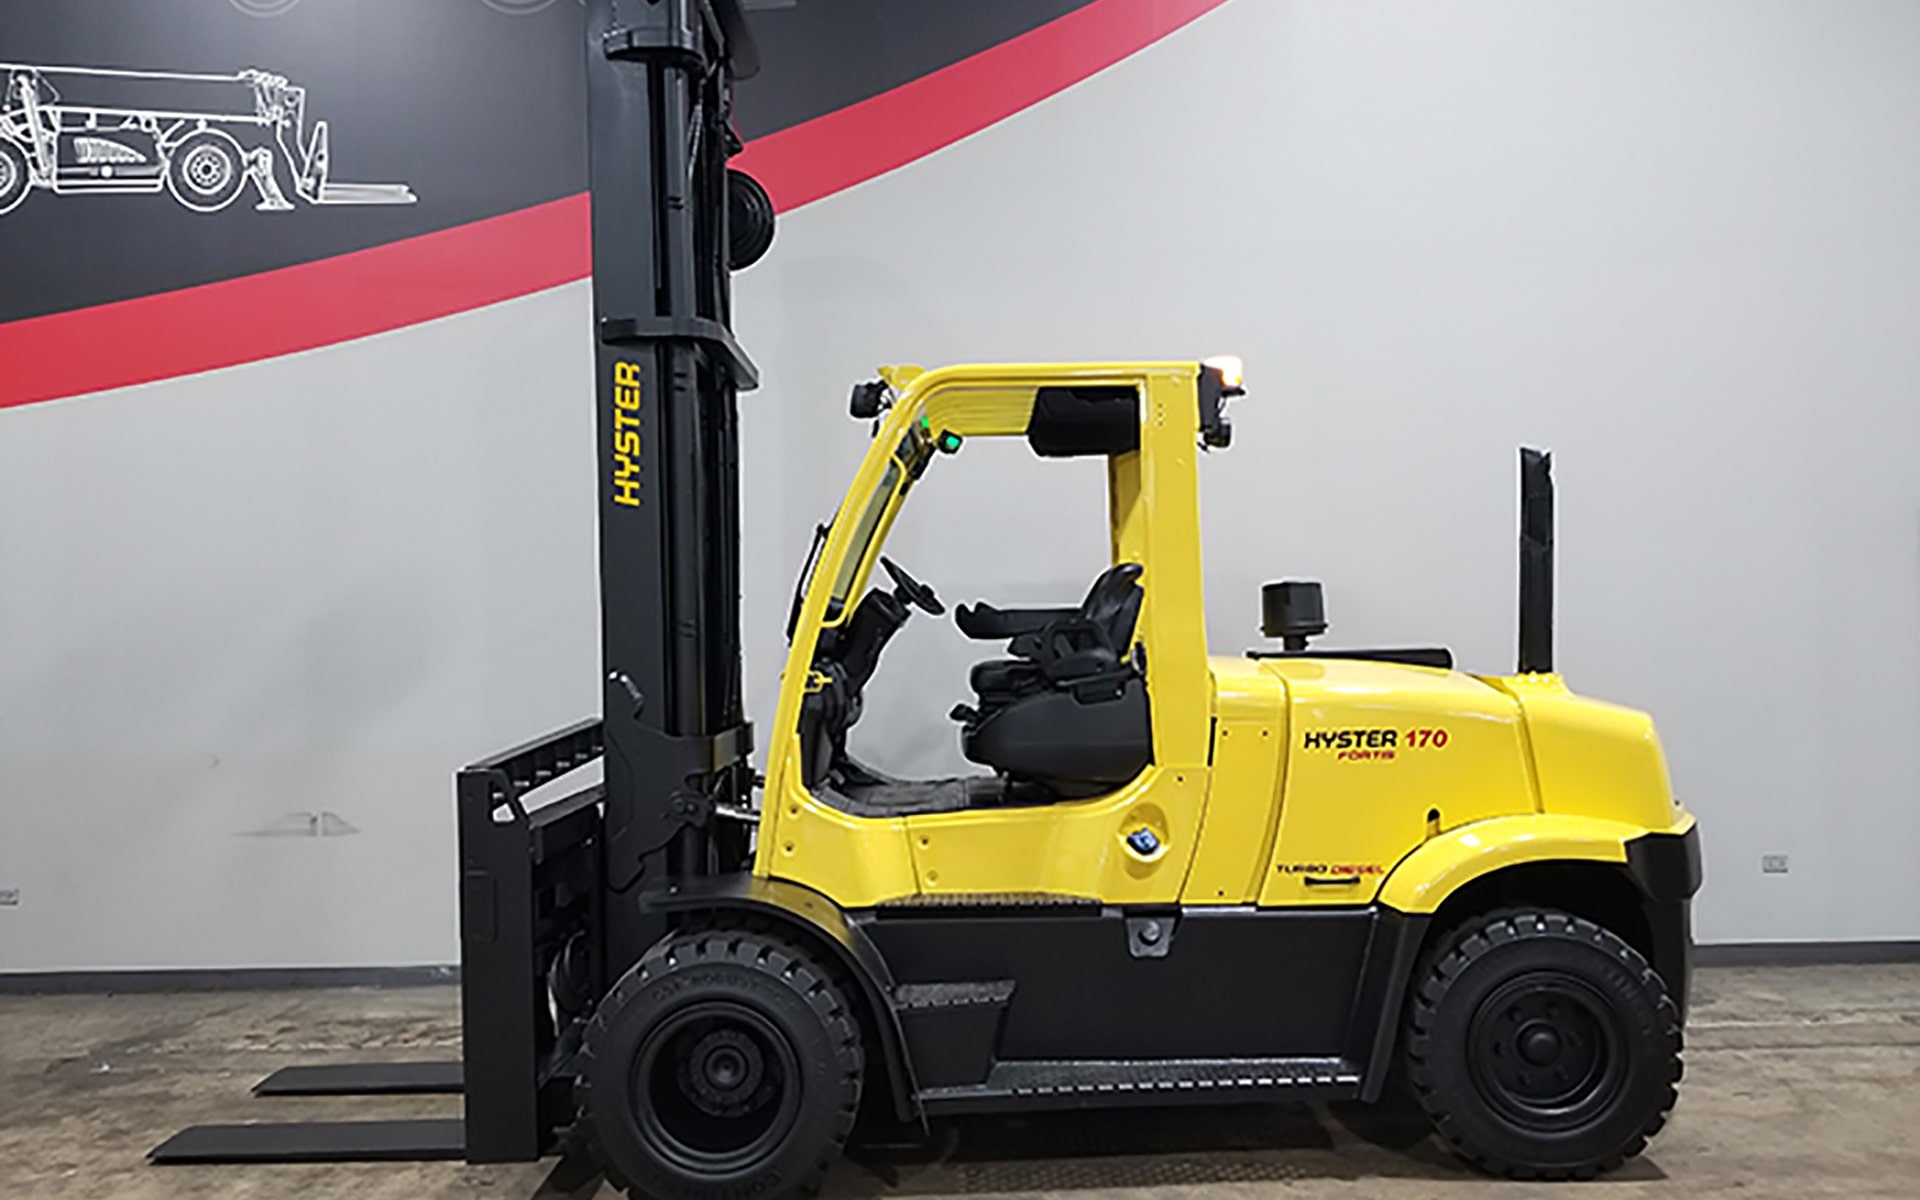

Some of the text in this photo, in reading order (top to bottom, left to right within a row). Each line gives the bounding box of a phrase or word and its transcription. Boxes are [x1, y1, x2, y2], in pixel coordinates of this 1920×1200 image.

[614, 361, 641, 506] HYSTER
[1304, 730, 1448, 748] HYSTER 170
[1338, 750, 1395, 760] FORTIS
[1276, 864, 1384, 875] TURBO DIESEL
